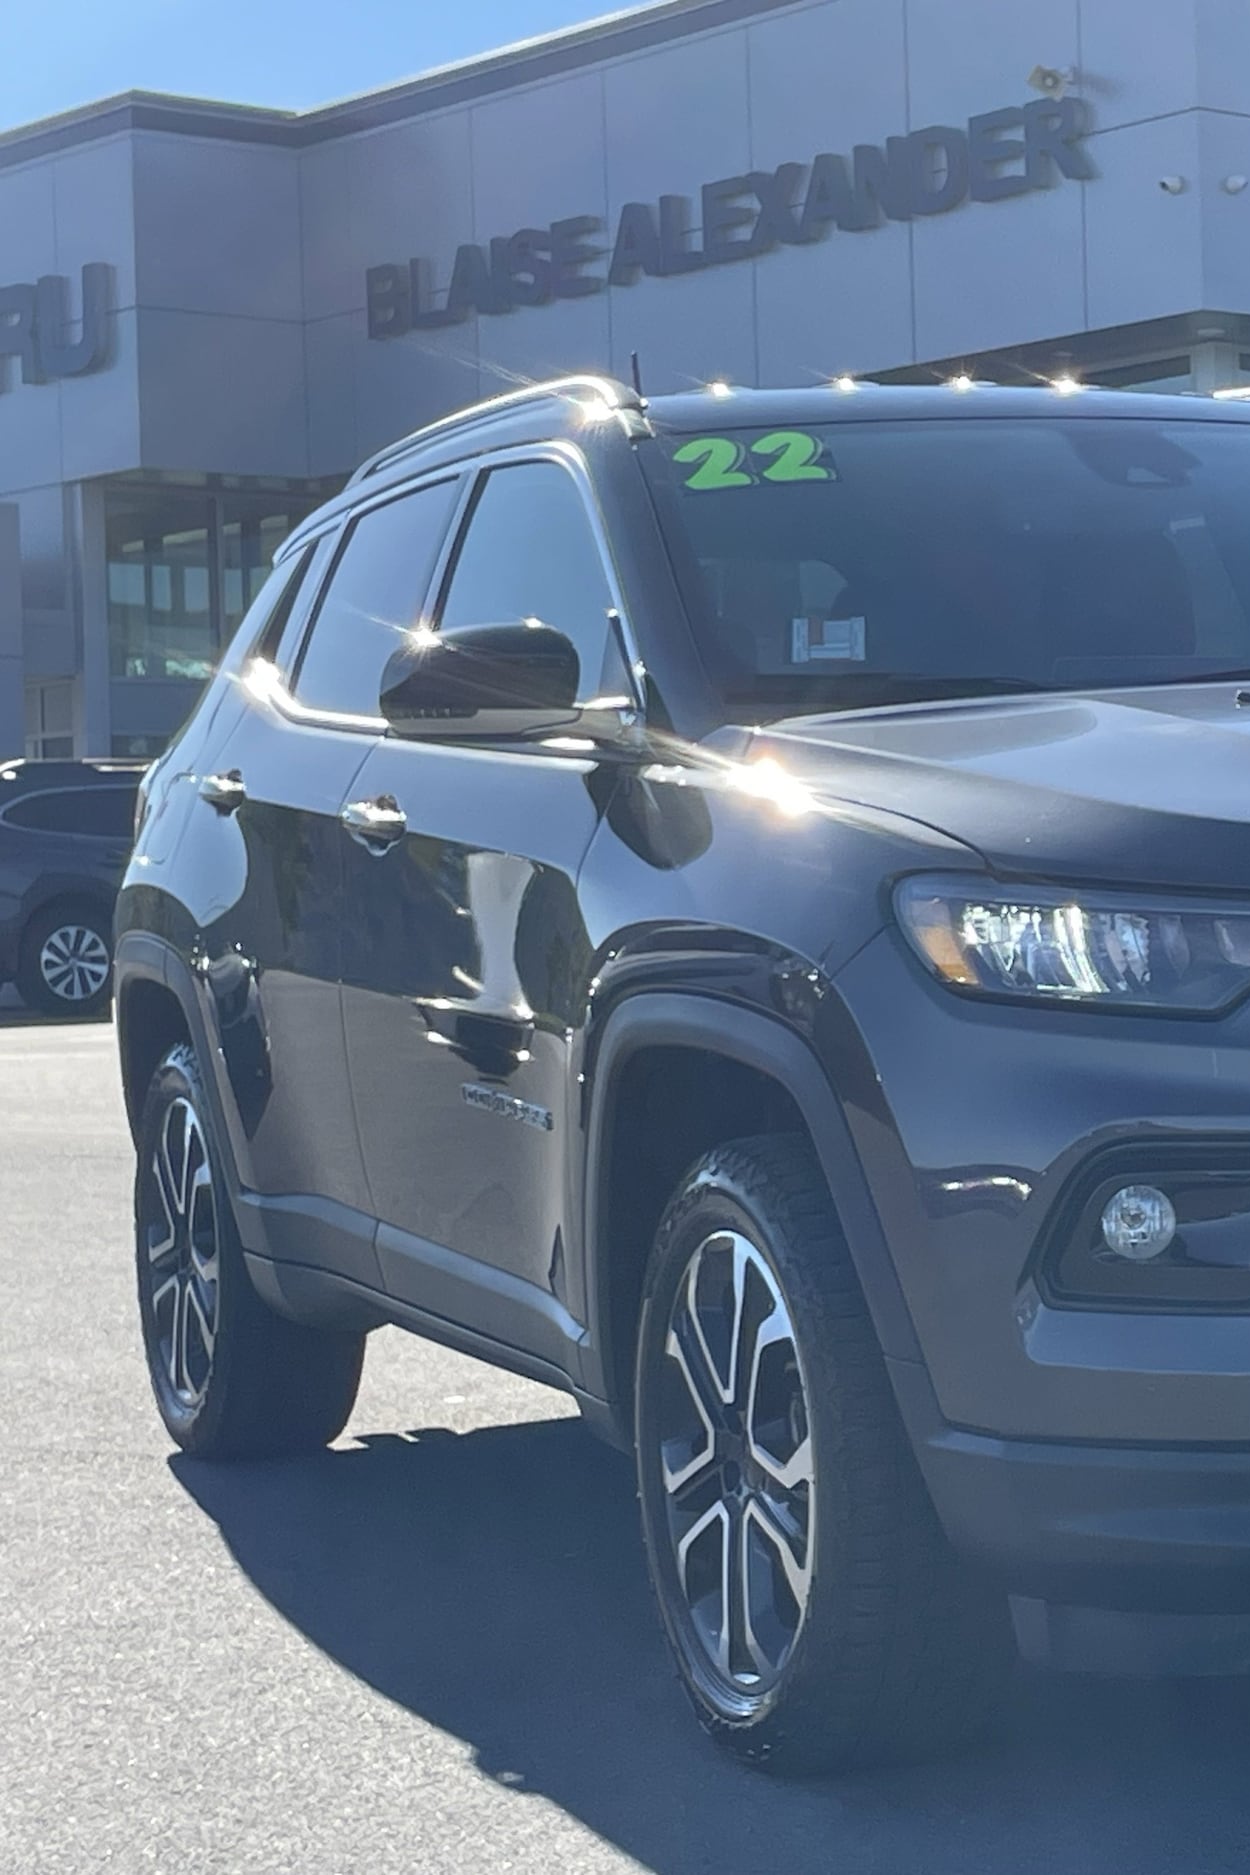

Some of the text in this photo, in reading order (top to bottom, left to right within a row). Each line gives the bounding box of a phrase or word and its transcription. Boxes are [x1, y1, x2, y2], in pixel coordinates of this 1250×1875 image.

[366, 96, 1098, 340] BLAISE ALEXANDER
[672, 431, 837, 490] 22
